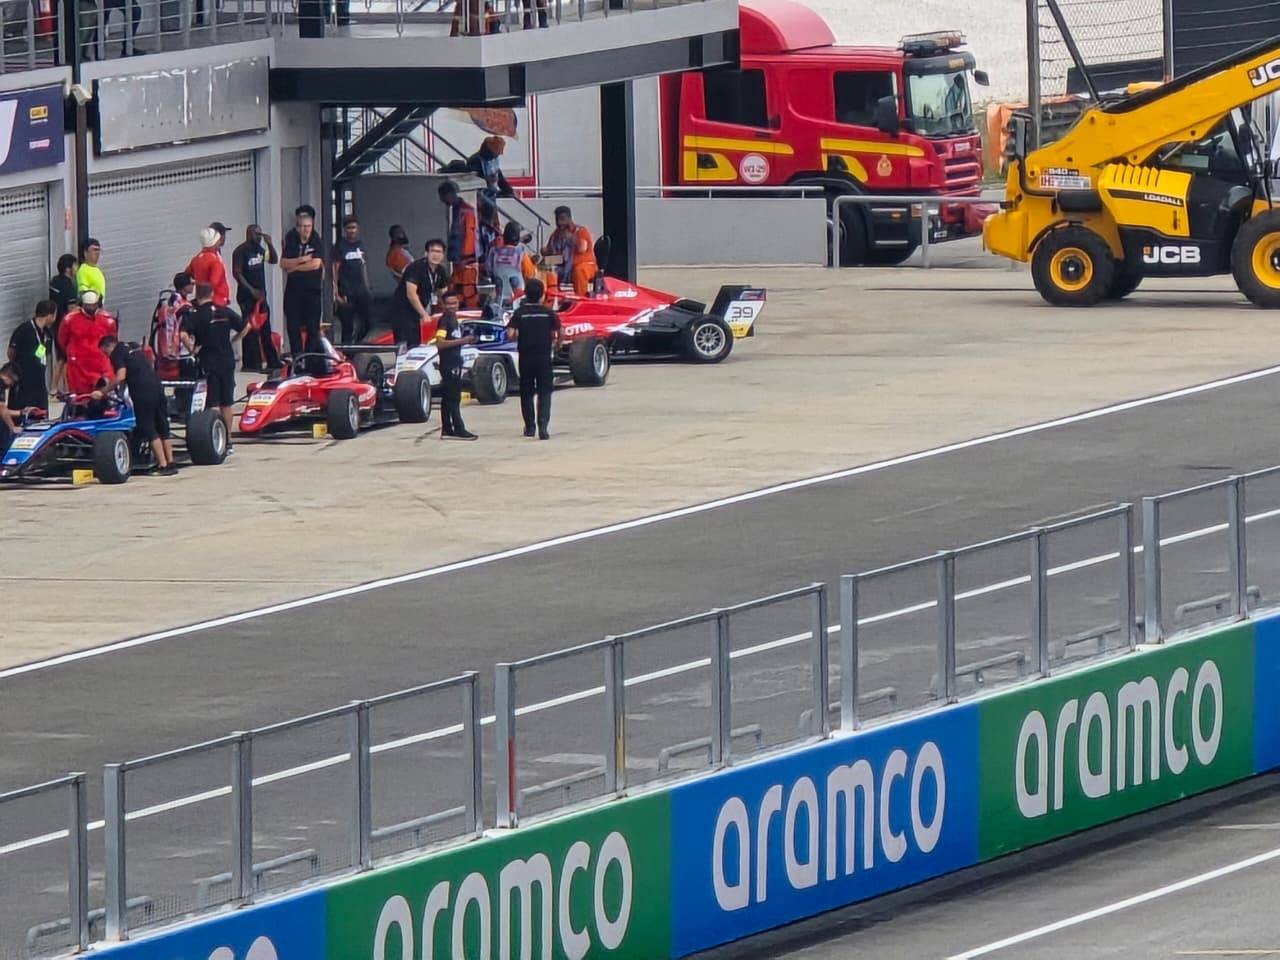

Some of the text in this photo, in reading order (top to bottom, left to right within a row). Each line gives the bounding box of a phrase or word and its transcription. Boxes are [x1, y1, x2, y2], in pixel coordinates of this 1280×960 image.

[1143, 193, 1182, 206] LOADALL
[1143, 245, 1201, 264] JCB
[731, 306, 753, 318] 39
[1016, 661, 1222, 817] aramco
[713, 742, 945, 910] aramco
[374, 832, 632, 960] aramco
